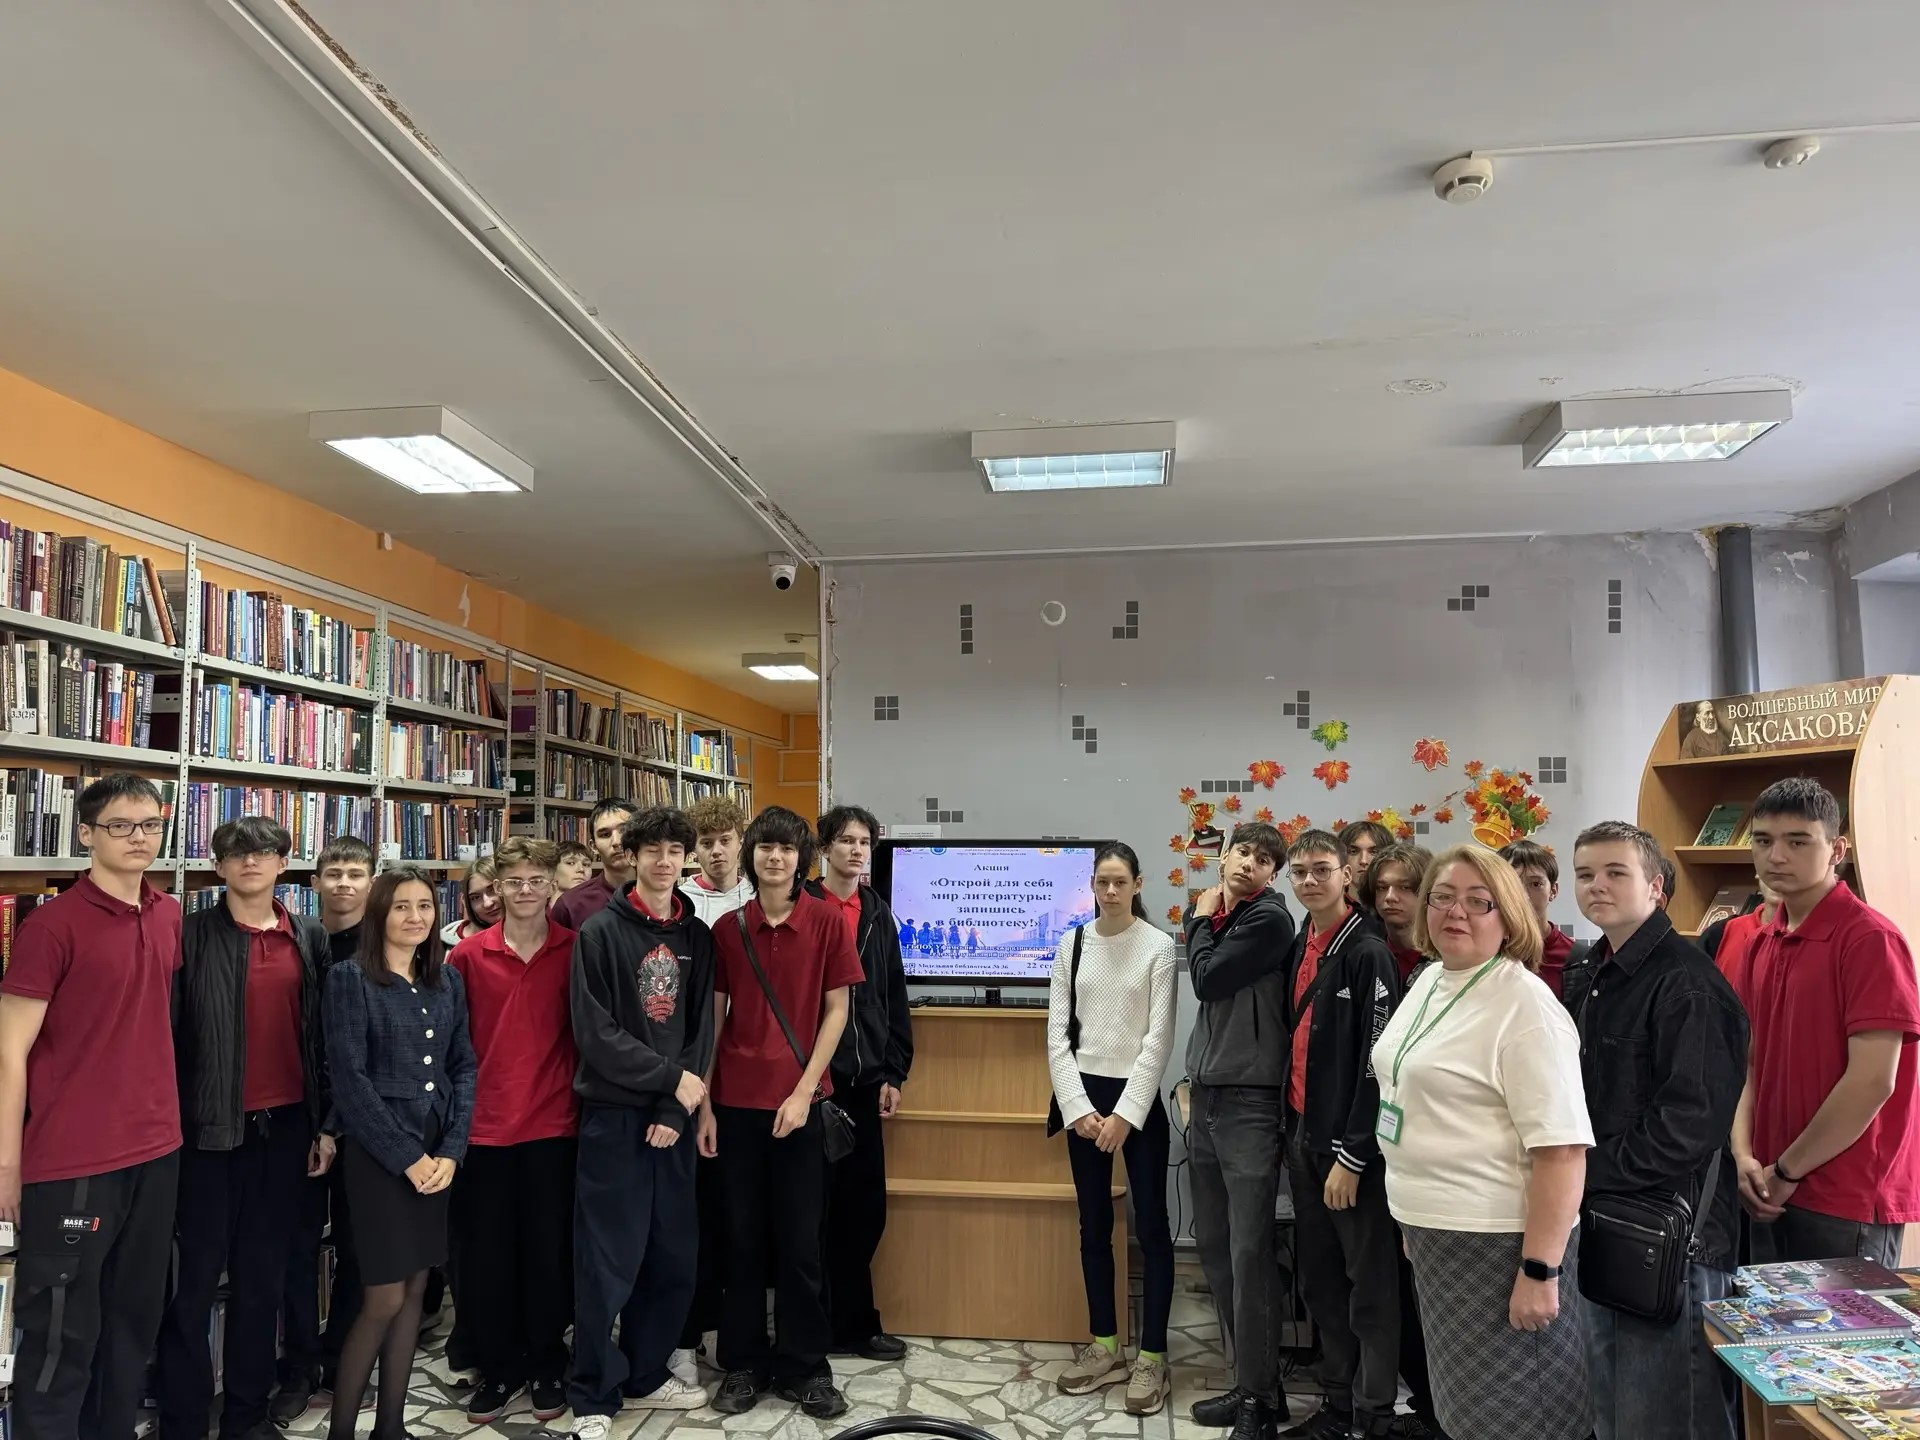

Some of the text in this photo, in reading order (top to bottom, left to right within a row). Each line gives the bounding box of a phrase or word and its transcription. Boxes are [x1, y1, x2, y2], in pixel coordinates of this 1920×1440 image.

[1727, 686, 1882, 719] ВОЛШЕБНЫЙ МИР
[1728, 708, 1869, 747] АКСАКОВА
[973, 863, 1010, 872] Акция
[930, 877, 1053, 889] «Открой для себя
[931, 892, 1052, 902] мир литературы:
[956, 905, 1026, 914] запишись
[935, 917, 1042, 929] в библиотеку!»
[64, 1218, 84, 1226] BASE
[1, 1358, 7, 1369] 4
